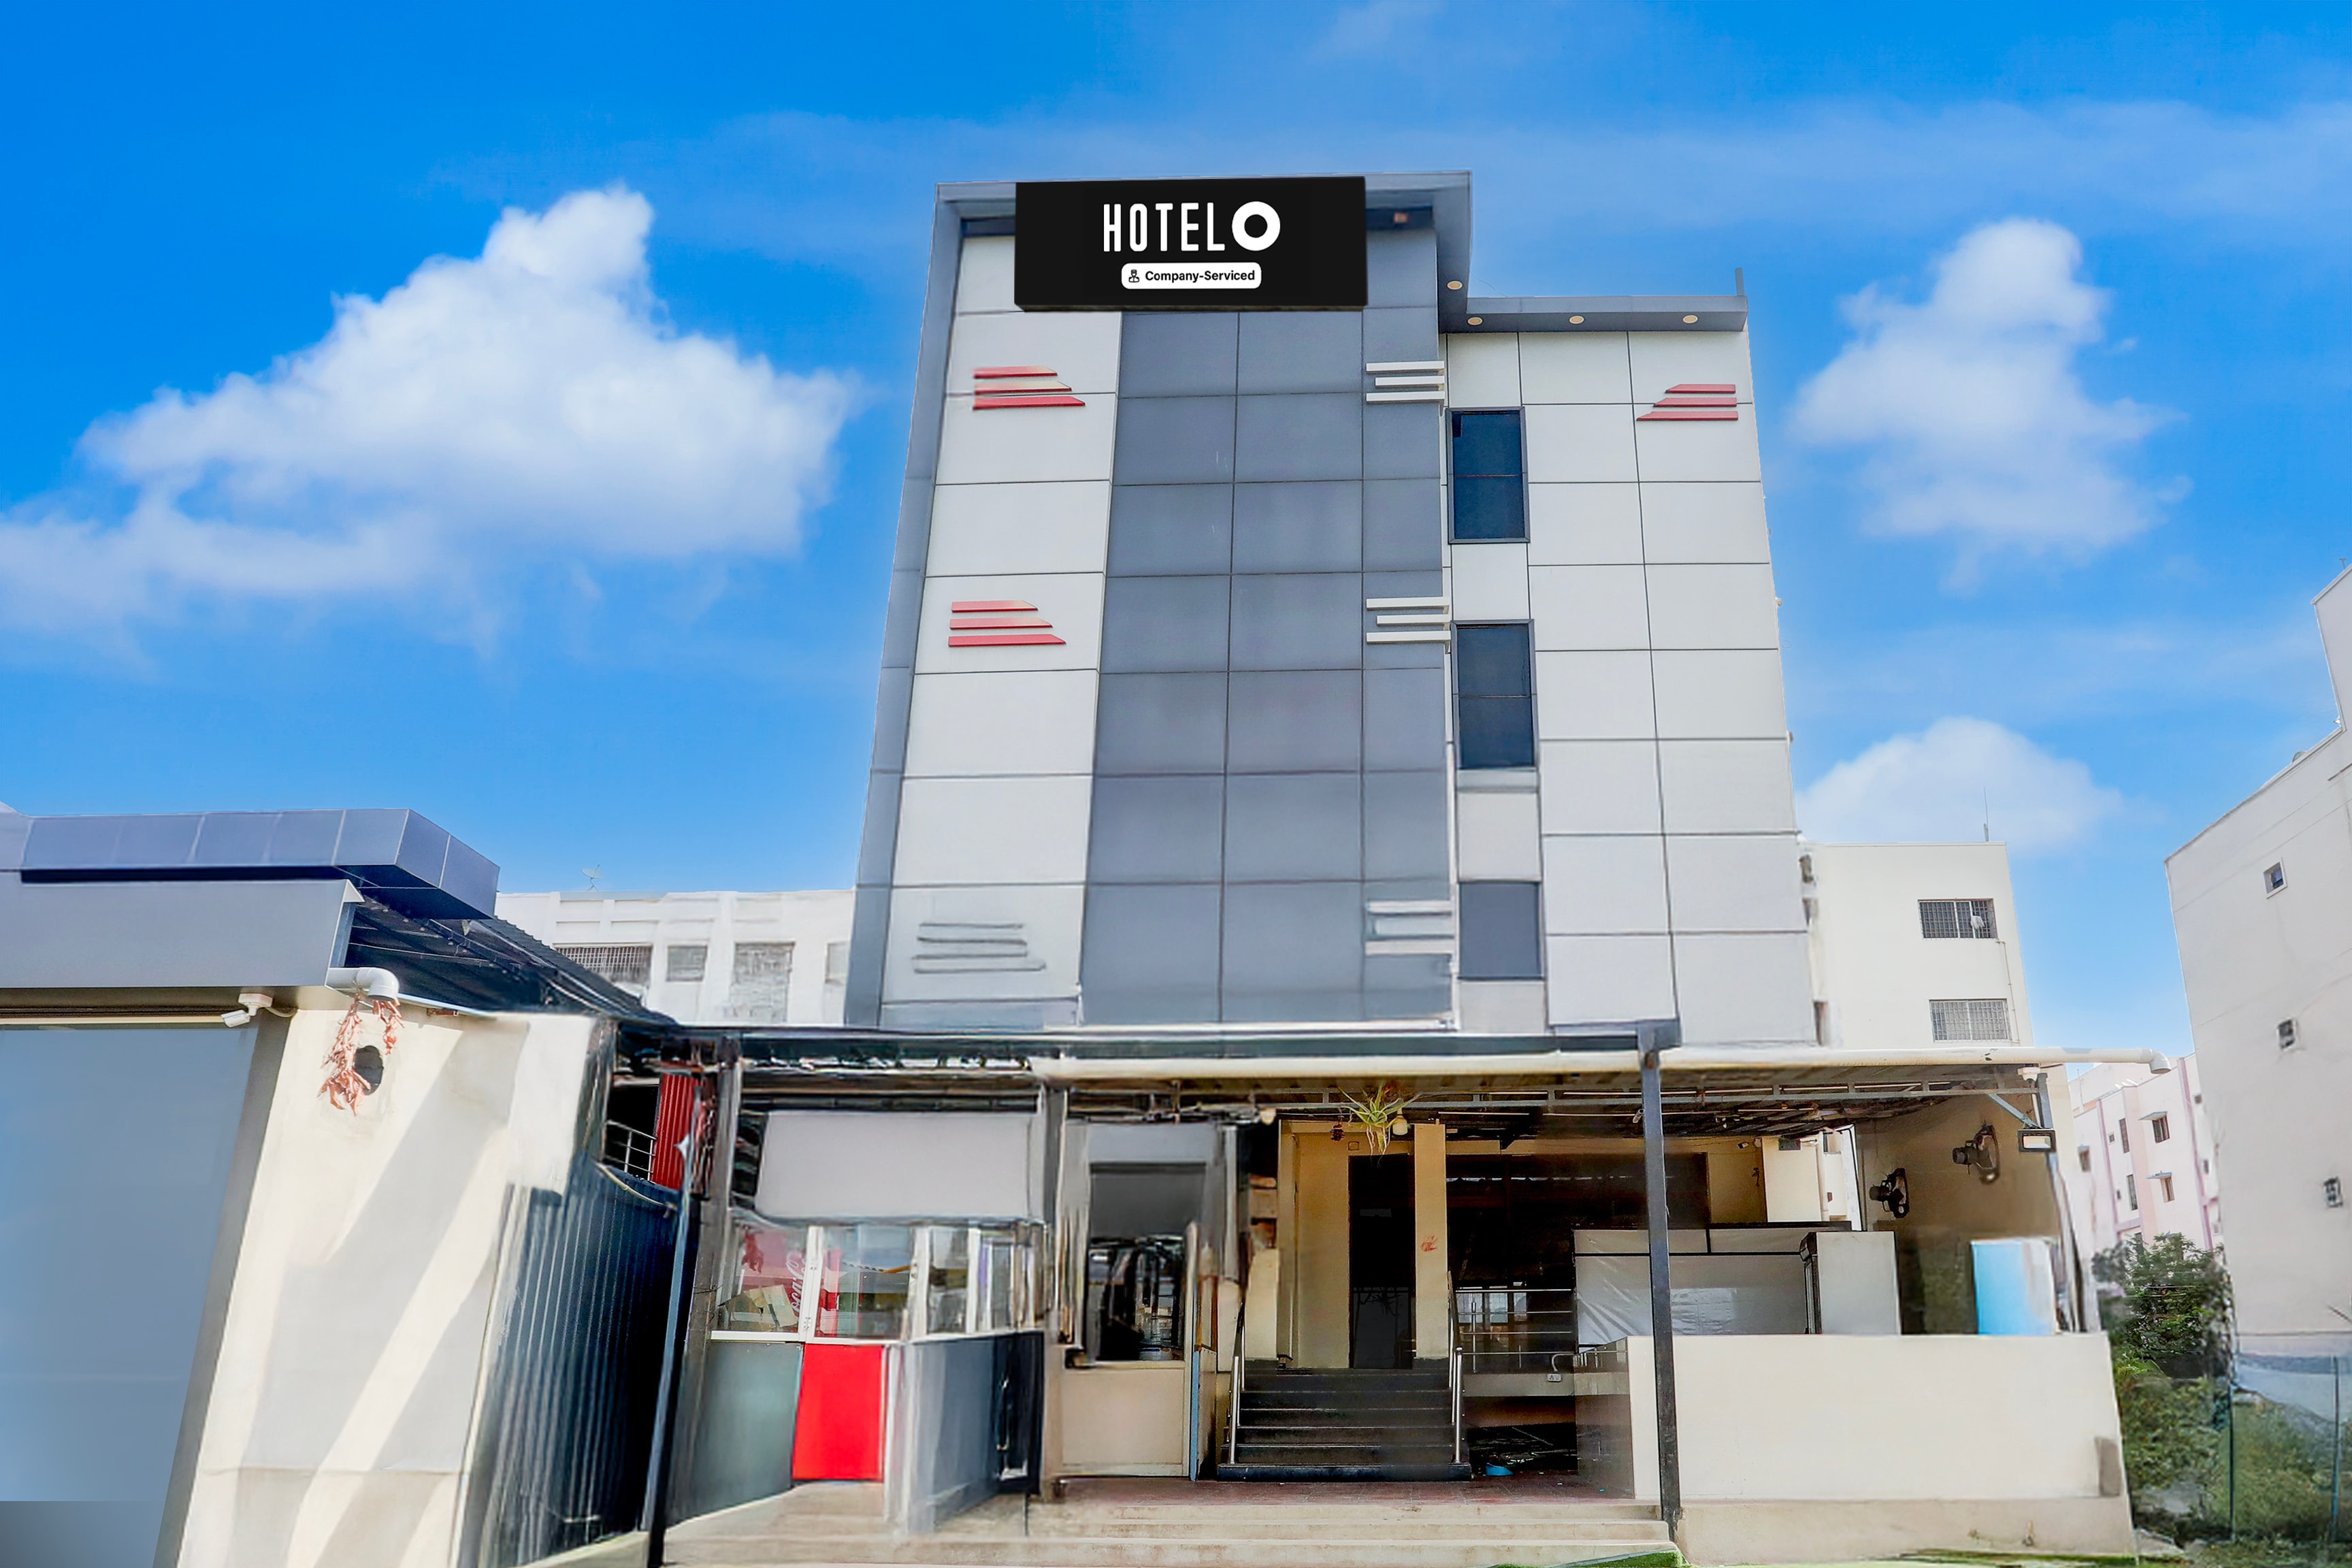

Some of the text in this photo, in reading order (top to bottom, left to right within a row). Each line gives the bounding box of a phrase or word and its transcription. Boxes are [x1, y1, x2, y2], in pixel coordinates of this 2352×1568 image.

[1103, 201, 1281, 252] HOTEL O
[1145, 270, 1255, 283] Company-Serviced
